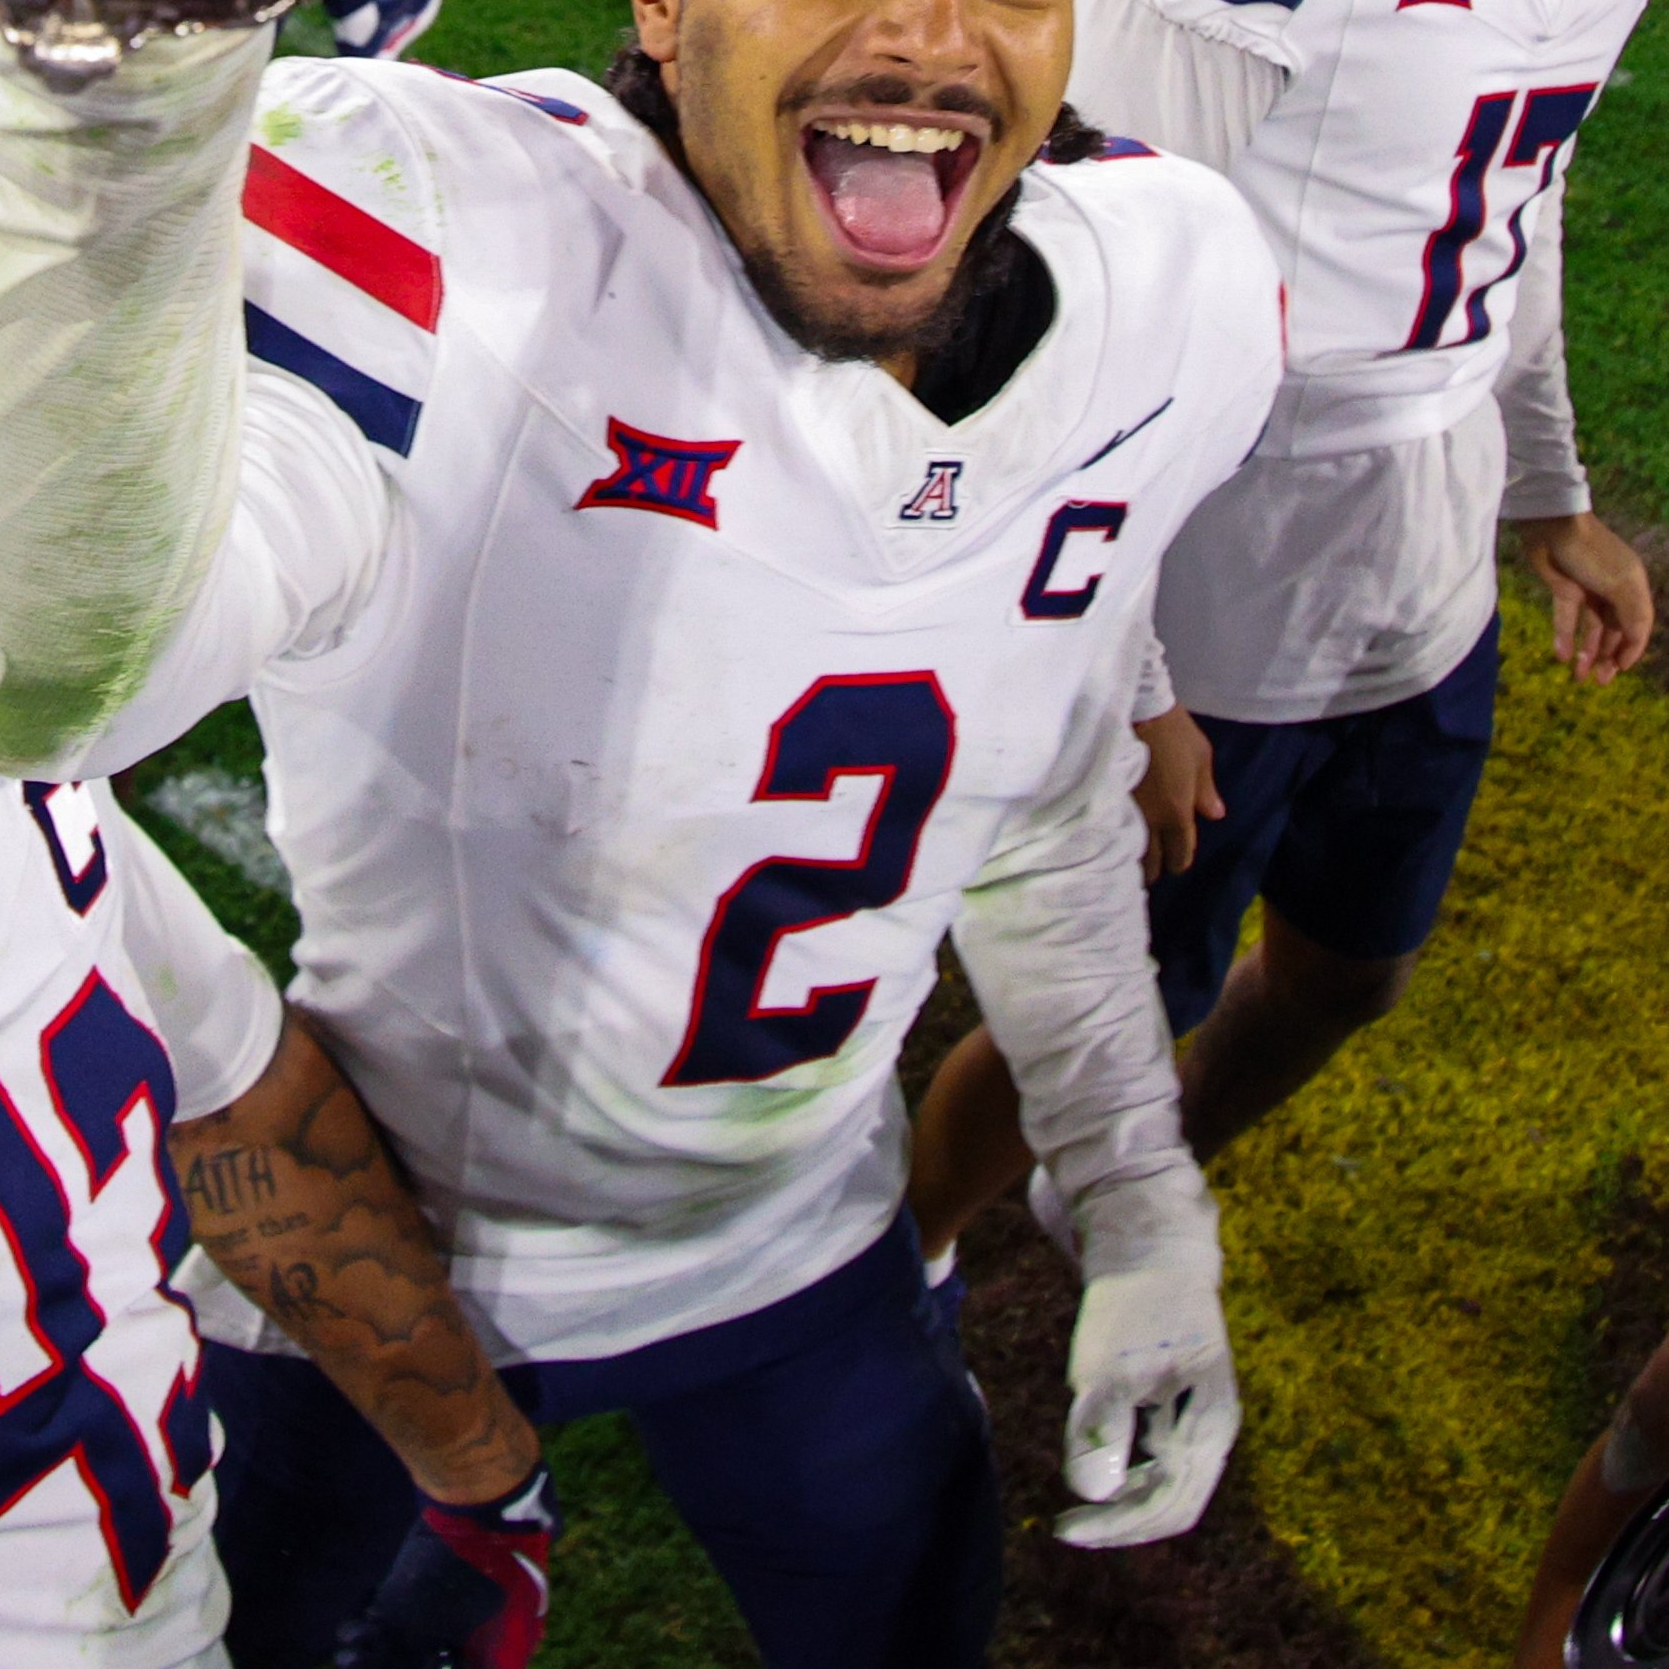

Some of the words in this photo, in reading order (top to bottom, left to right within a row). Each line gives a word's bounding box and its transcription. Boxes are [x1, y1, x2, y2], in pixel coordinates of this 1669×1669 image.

[1403, 81, 1601, 351] 17
[592, 431, 729, 516] XII
[899, 461, 964, 520] A
[1019, 499, 1128, 621] C
[21, 779, 109, 915] C
[658, 669, 958, 1089] 2
[184, 1145, 278, 1214] AITH
